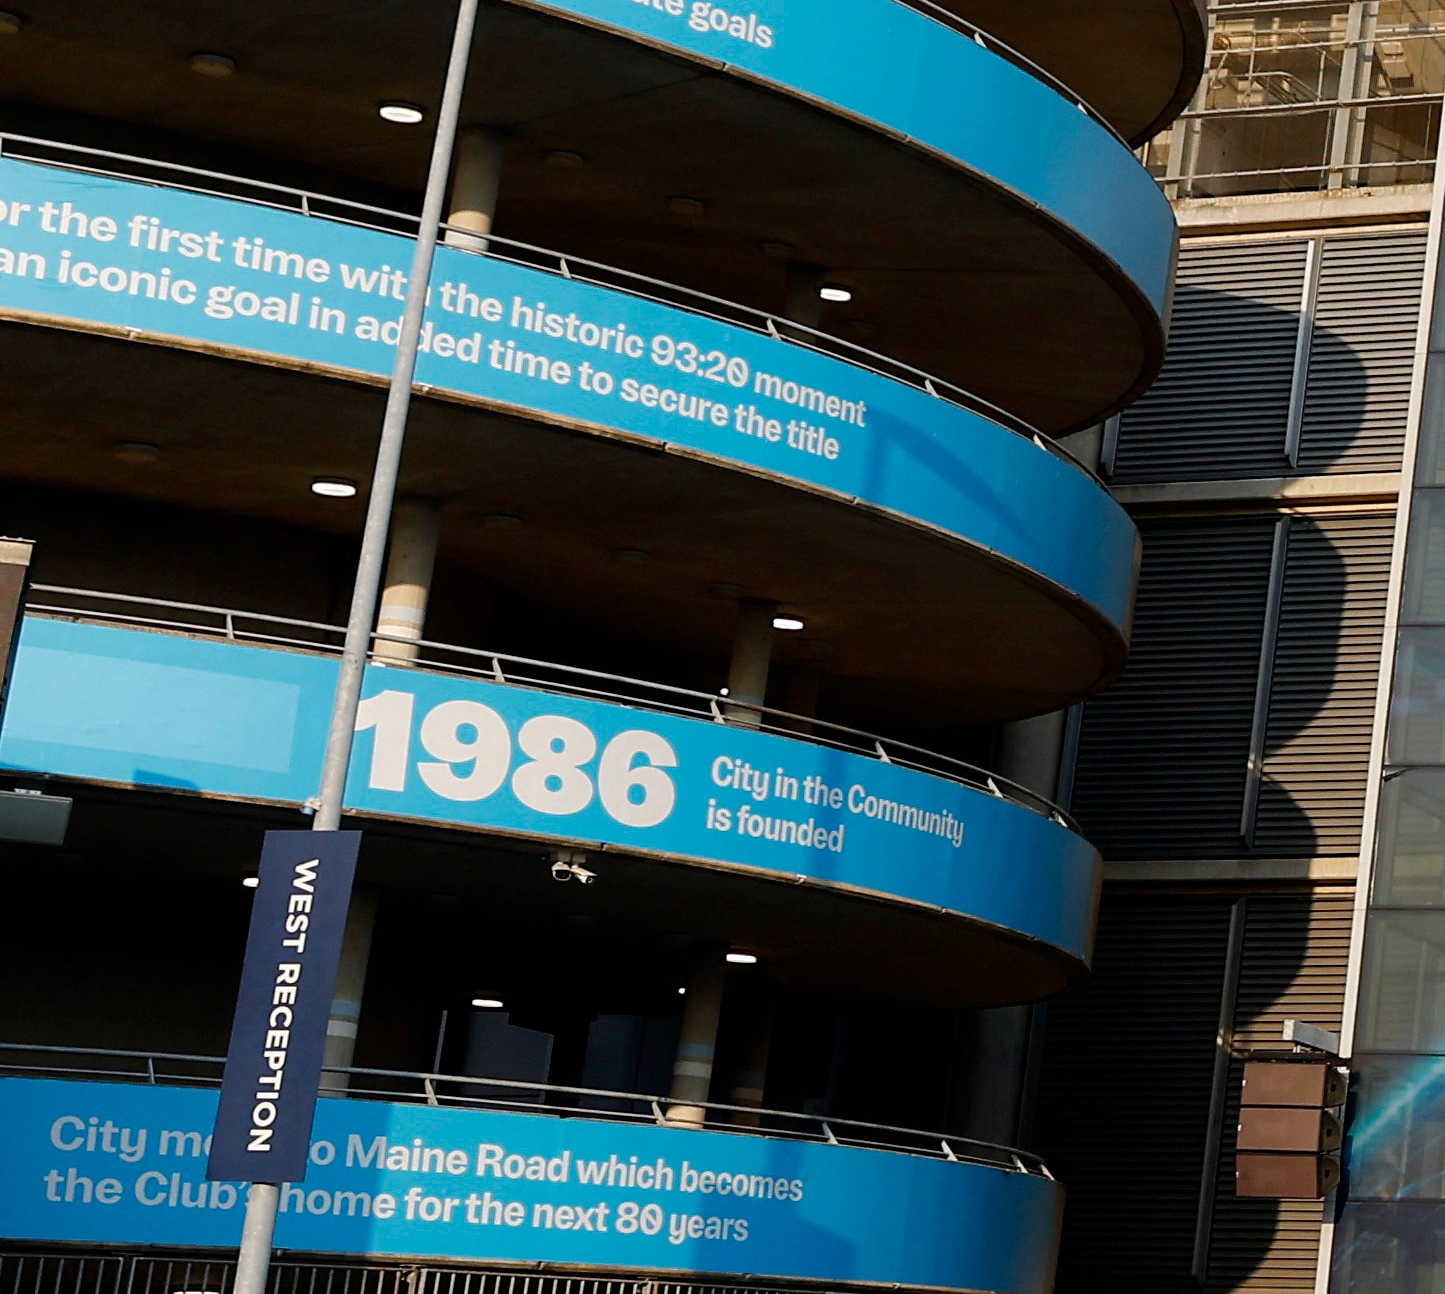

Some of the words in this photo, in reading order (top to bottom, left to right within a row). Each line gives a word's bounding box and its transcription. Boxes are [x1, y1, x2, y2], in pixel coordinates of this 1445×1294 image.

[688, 0, 773, 49] goals
[38, 202, 117, 241] the
[128, 215, 224, 263] first
[232, 237, 330, 283] time
[441, 282, 502, 322] the
[510, 297, 645, 359] historic
[650, 335, 749, 388] 93:20
[753, 369, 867, 427] moment
[59, 250, 197, 305] iconic
[205, 284, 299, 324] goal
[309, 296, 346, 335] in
[489, 340, 571, 385] time
[578, 363, 613, 395] to
[621, 378, 730, 427] secure
[735, 404, 782, 444] the
[786, 421, 841, 460] title
[354, 689, 679, 828] 1986
[710, 756, 771, 801] City
[777, 766, 801, 800] in
[801, 772, 844, 810] the
[847, 785, 966, 849] Community
[706, 799, 732, 832] is
[736, 805, 845, 853] founded
[282, 859, 320, 953] WEST
[247, 963, 301, 1152] RECEPTION
[50, 1115, 147, 1162] City
[345, 1134, 468, 1175] Maine
[477, 1144, 570, 1183] Road
[577, 1154, 673, 1191] which
[680, 1161, 803, 1202] becomes
[44, 1168, 123, 1204] the
[279, 1183, 395, 1219] home
[404, 1187, 455, 1222] for
[465, 1193, 525, 1227] the
[532, 1202, 609, 1233] next
[616, 1202, 663, 1235] 80
[668, 1213, 749, 1245] years
